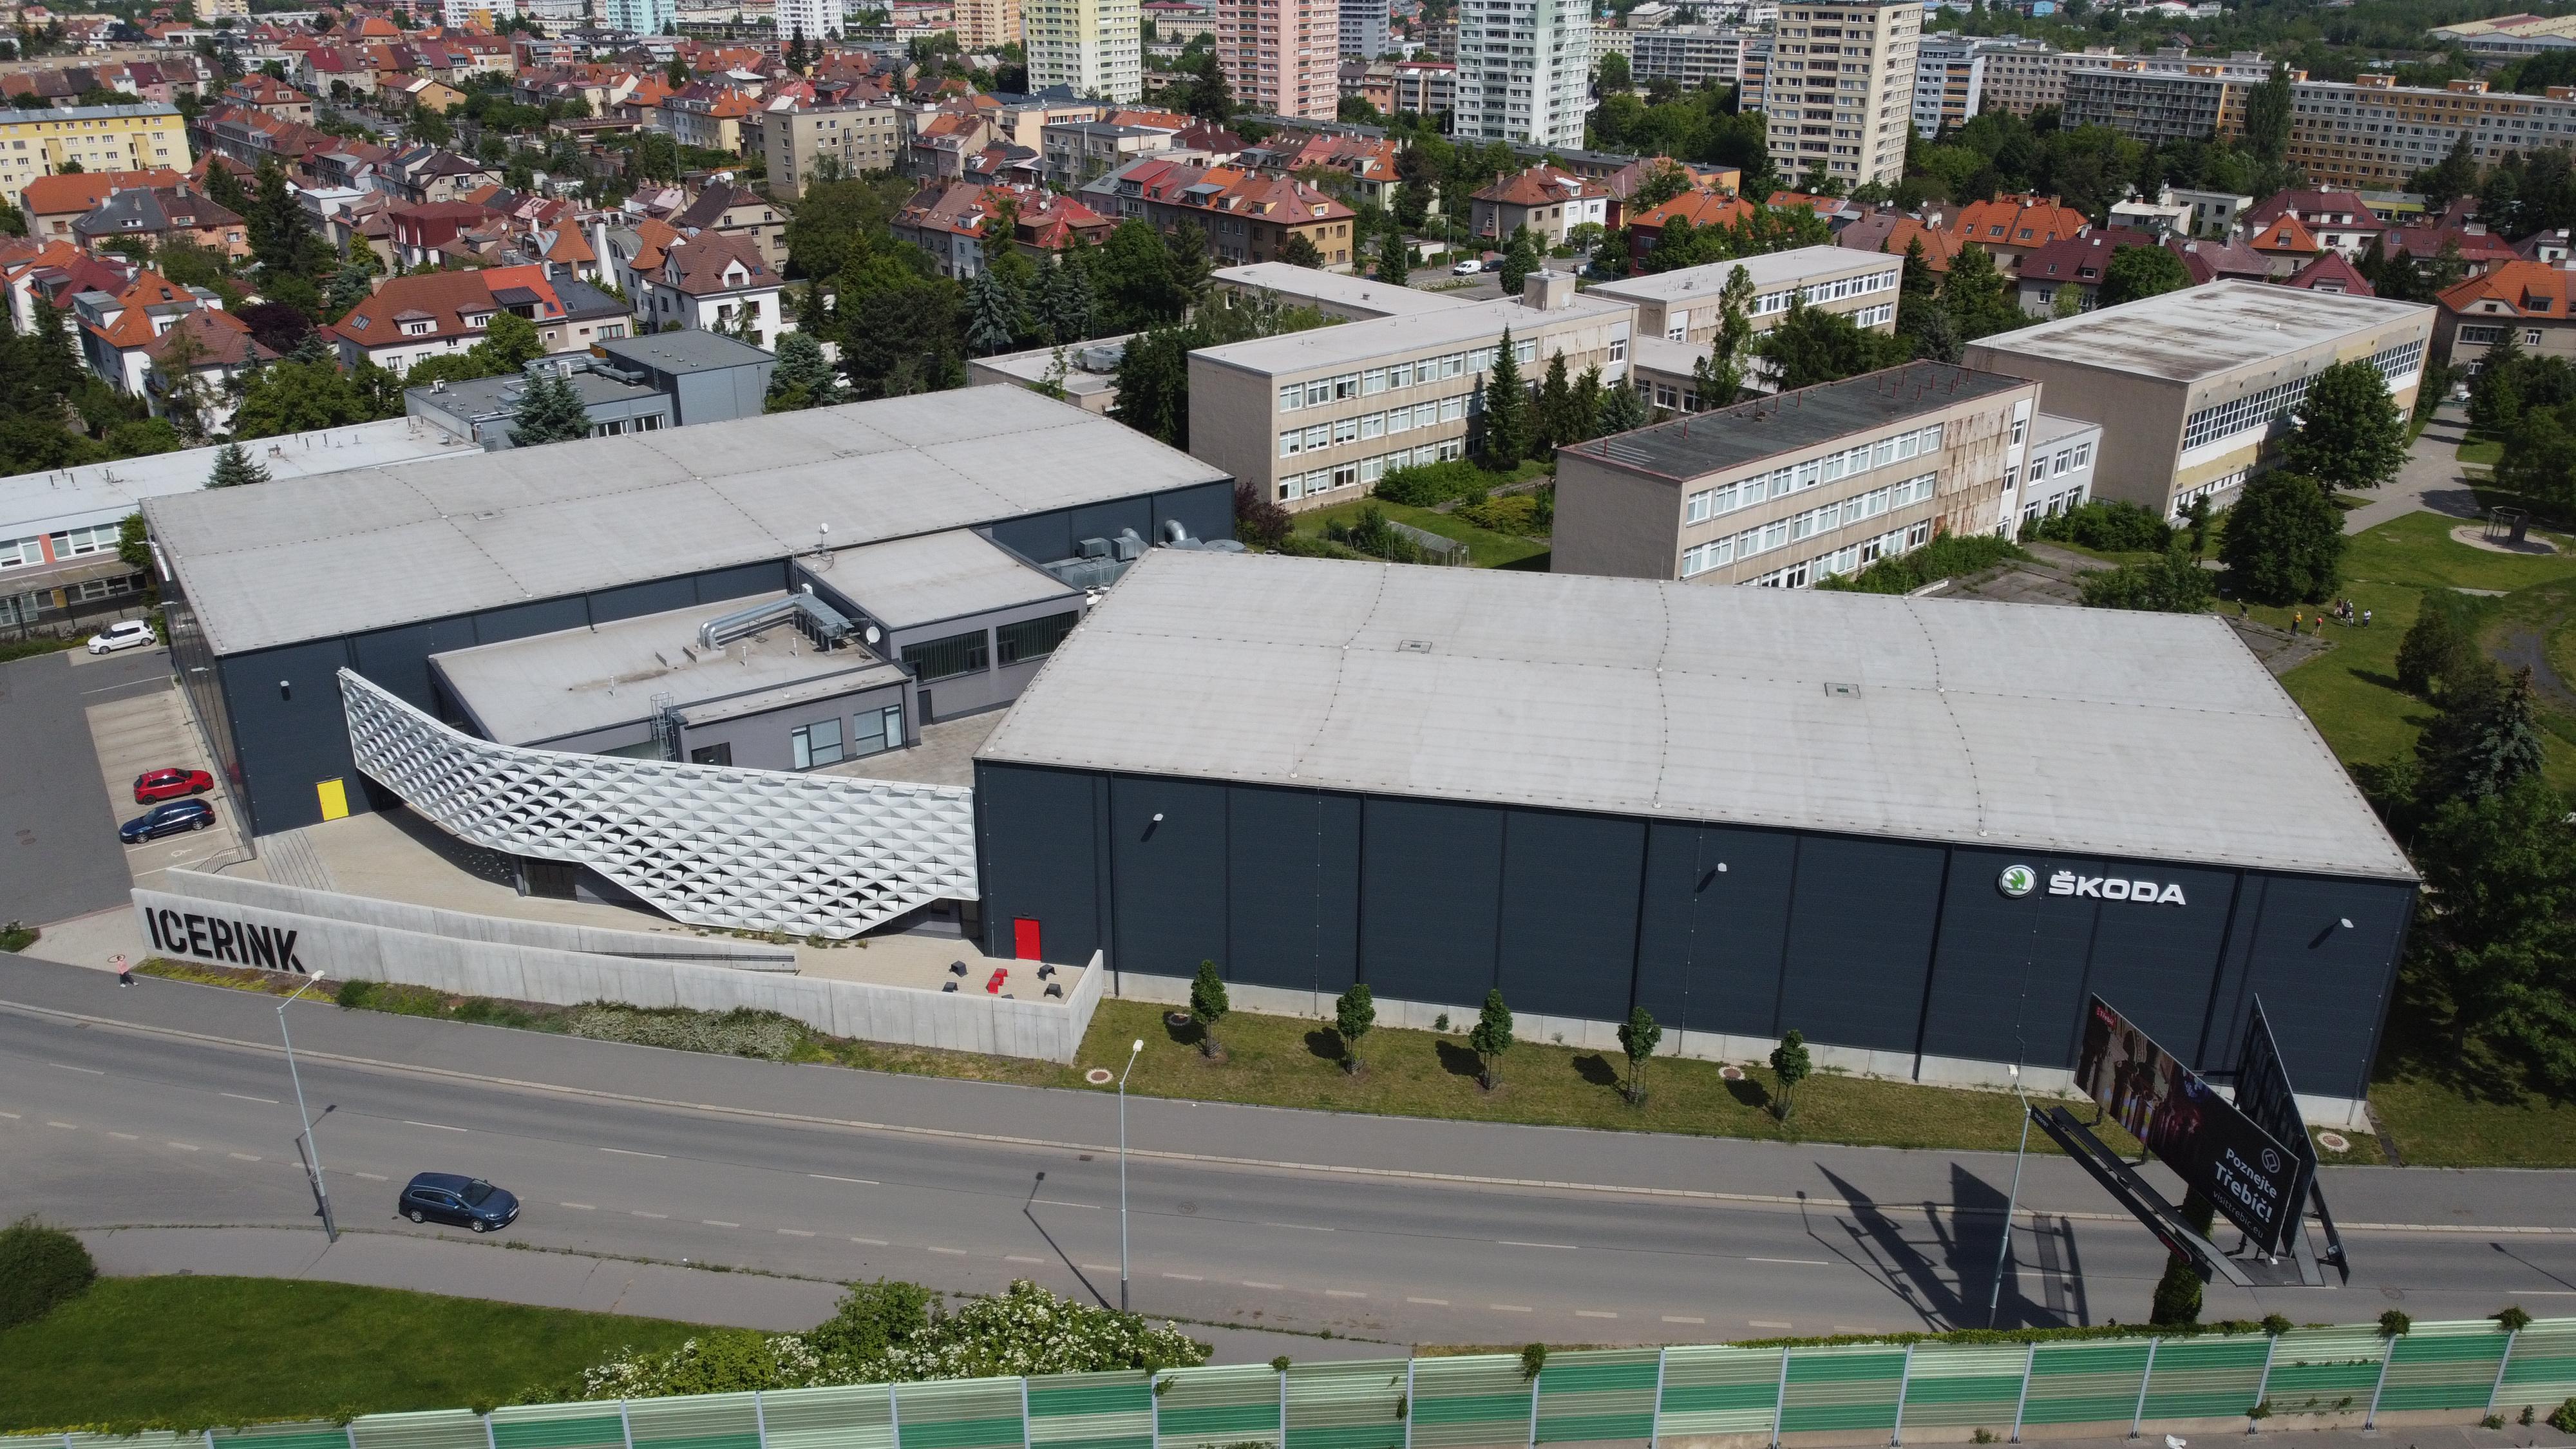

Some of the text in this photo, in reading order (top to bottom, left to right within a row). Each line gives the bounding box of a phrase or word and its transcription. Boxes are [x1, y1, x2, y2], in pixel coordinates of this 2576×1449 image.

[2049, 871, 2186, 905] ŠKODA
[145, 907, 307, 974] ICERINK
[2215, 1160, 2273, 1224] Třebíč!
[2225, 1148, 2277, 1199] Poznejte
[2213, 1191, 2264, 1238] visittrebic.eu
